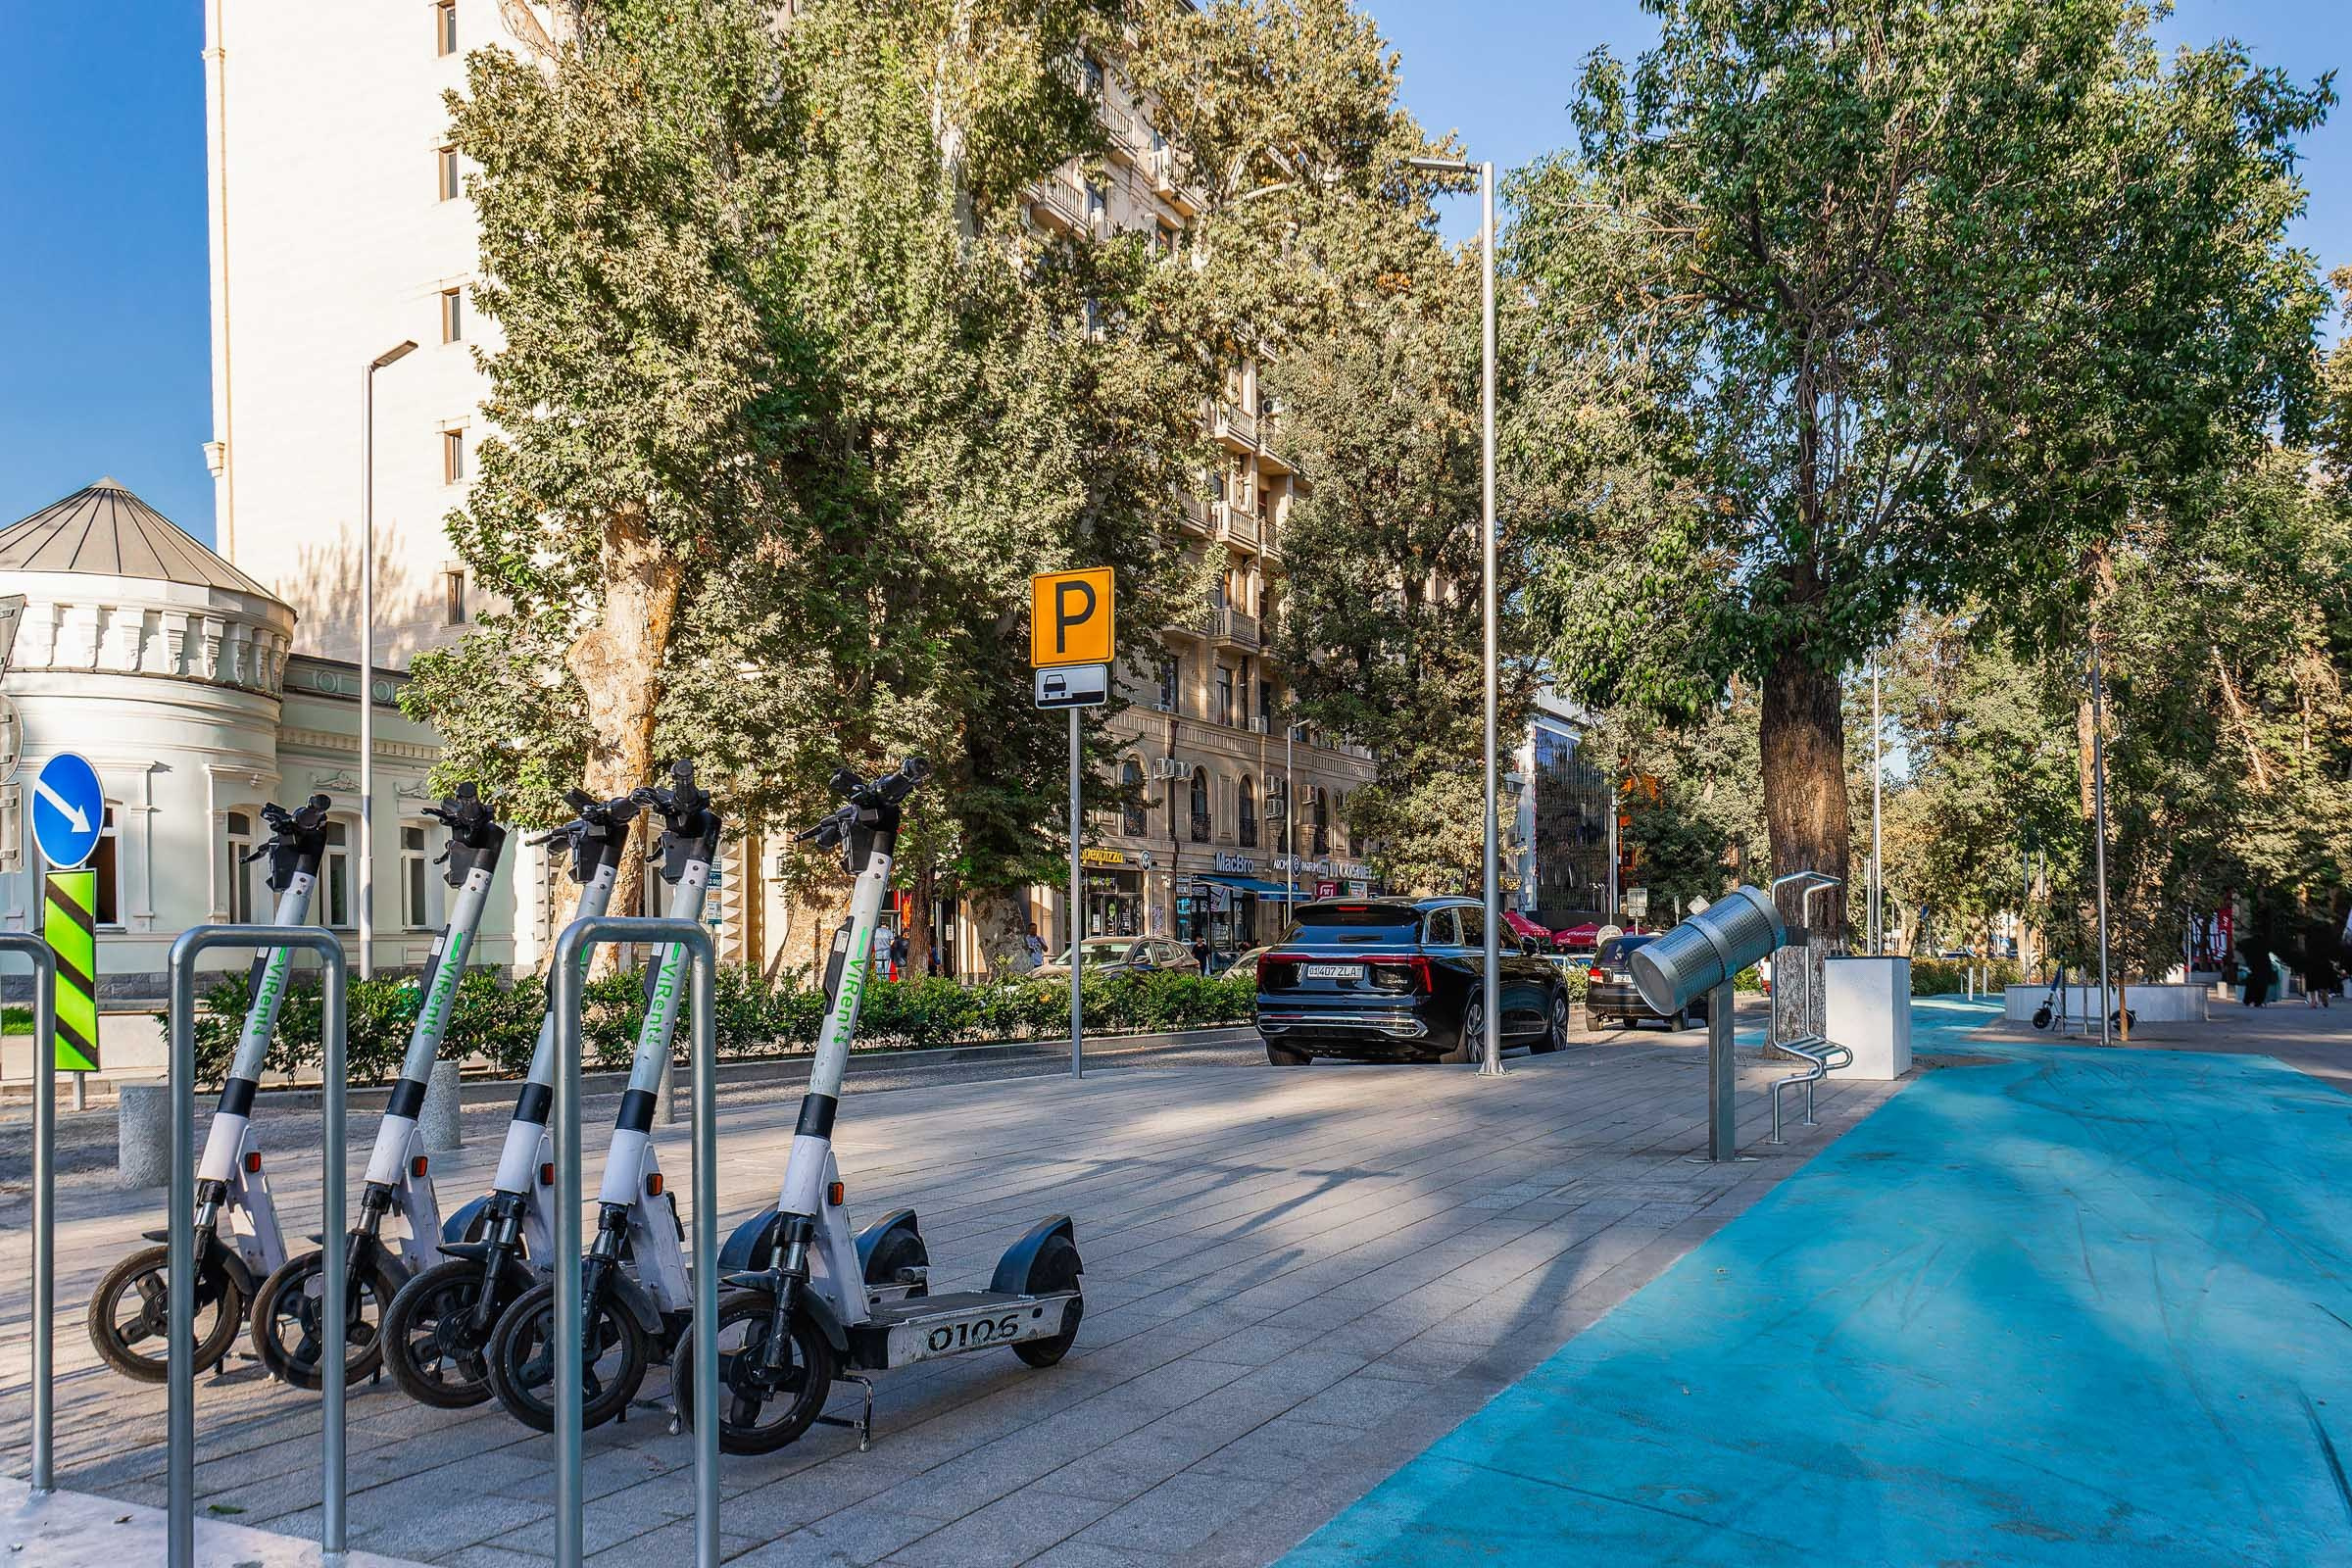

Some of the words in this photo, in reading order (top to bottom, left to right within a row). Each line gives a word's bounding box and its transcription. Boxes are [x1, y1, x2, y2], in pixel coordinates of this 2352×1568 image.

[1055, 580, 1096, 654] P
[253, 963, 285, 1026] ViRent
[424, 960, 459, 1026] ViRent
[647, 963, 678, 1032] ViRent
[837, 959, 865, 1033] ViRent
[1319, 966, 1336, 976] 407
[1338, 967, 1356, 977] ZLA
[928, 1313, 1020, 1352] 0106
